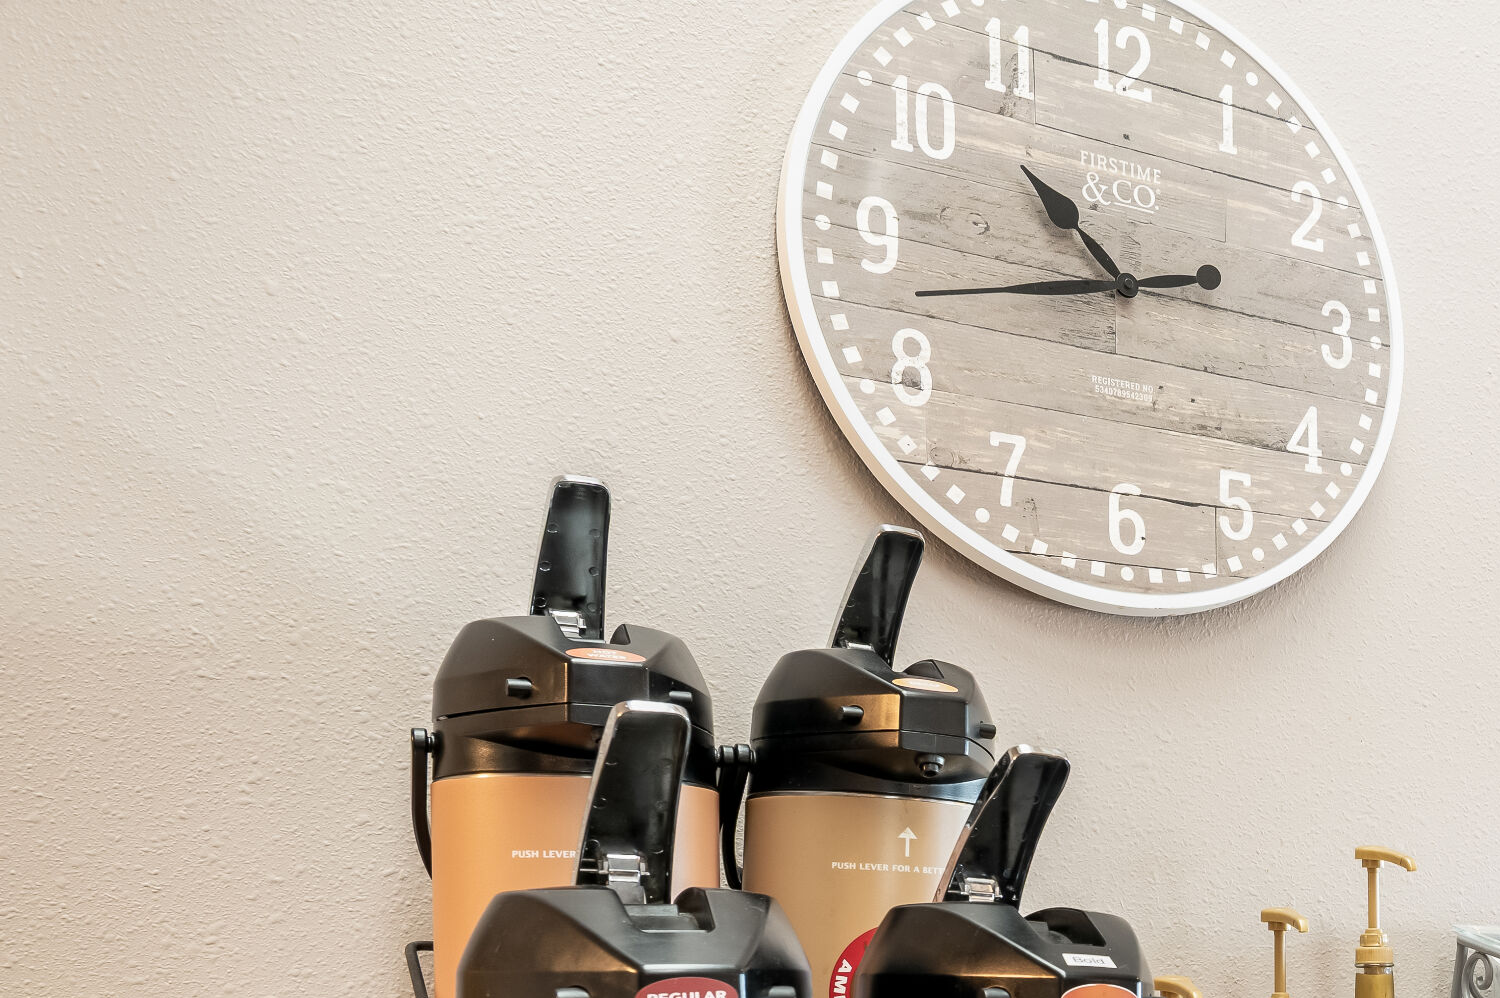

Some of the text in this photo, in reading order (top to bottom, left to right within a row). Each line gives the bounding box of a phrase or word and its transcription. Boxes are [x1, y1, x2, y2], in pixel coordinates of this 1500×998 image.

[984, 18, 1034, 100] 11
[1093, 19, 1152, 100] 12
[890, 76, 955, 160] 10
[1218, 85, 1237, 155] 1
[1080, 150, 1161, 184] FIRSTIME
[856, 196, 899, 273] 9
[1291, 181, 1324, 253] 2
[890, 328, 931, 406] 8
[1321, 301, 1352, 369] 3
[1091, 375, 1140, 391] REGISTERED
[989, 433, 1026, 506] 7
[1287, 406, 1322, 473] 4
[1109, 484, 1146, 555] 6
[1219, 469, 1253, 540] 5
[511, 850, 576, 859] PUSH LEVER
[832, 861, 945, 874] PUSH LEVER FOR A BETT
